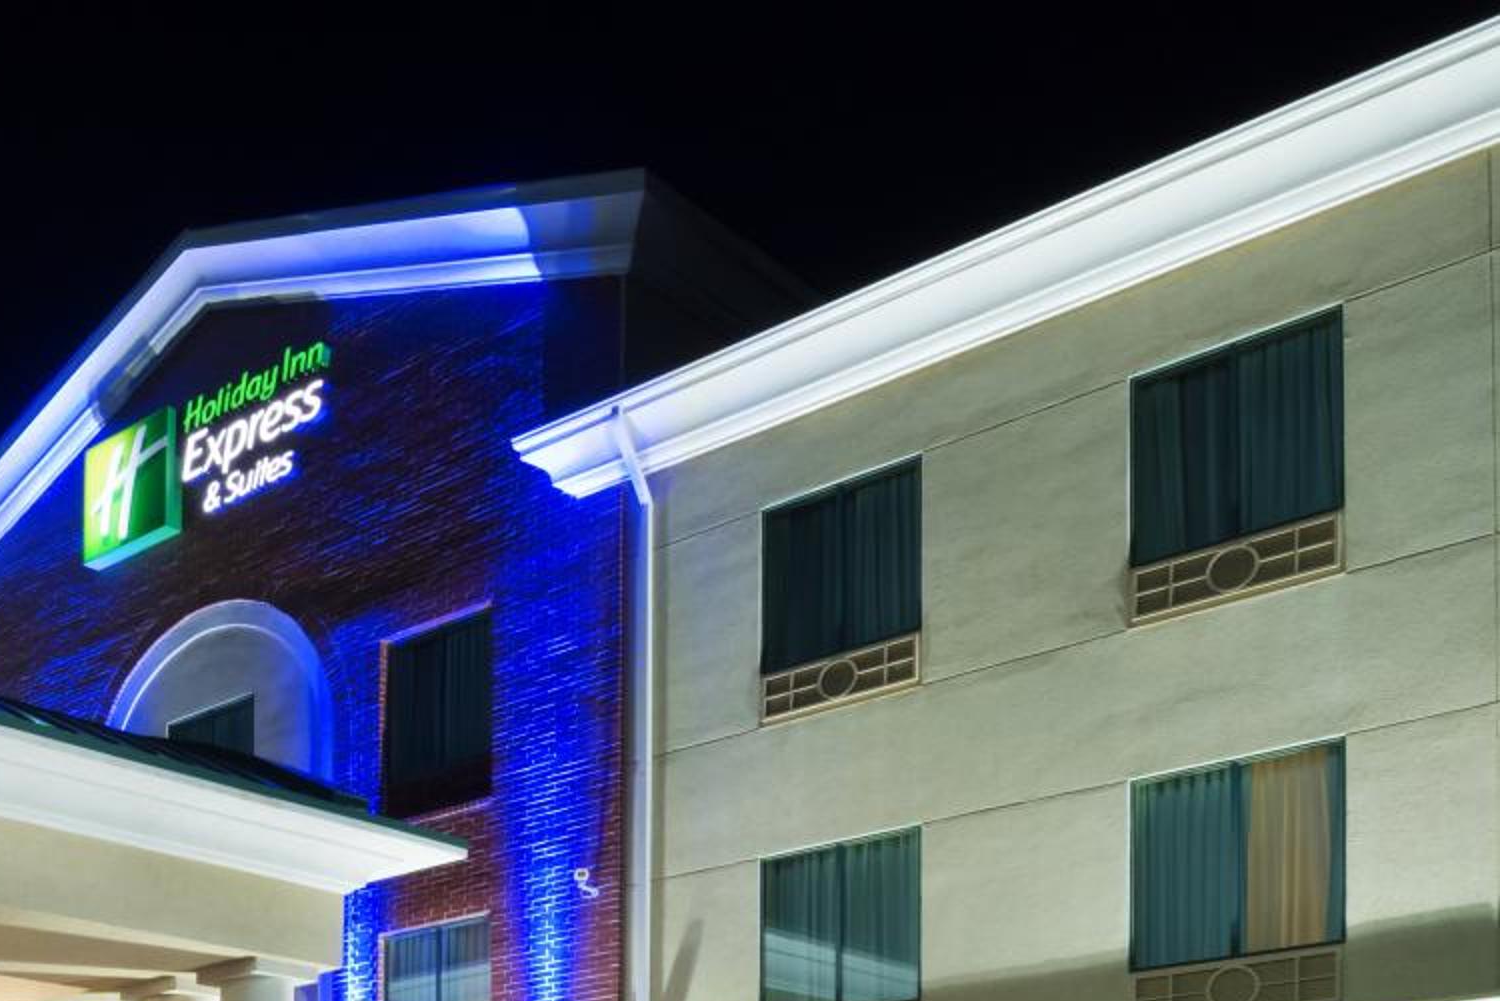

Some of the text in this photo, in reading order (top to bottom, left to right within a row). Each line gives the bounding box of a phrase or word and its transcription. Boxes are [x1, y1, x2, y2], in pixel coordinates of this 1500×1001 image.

[182, 379, 325, 482] Express
[184, 341, 326, 433] Holiday Inn
[202, 450, 294, 514] & Suites
